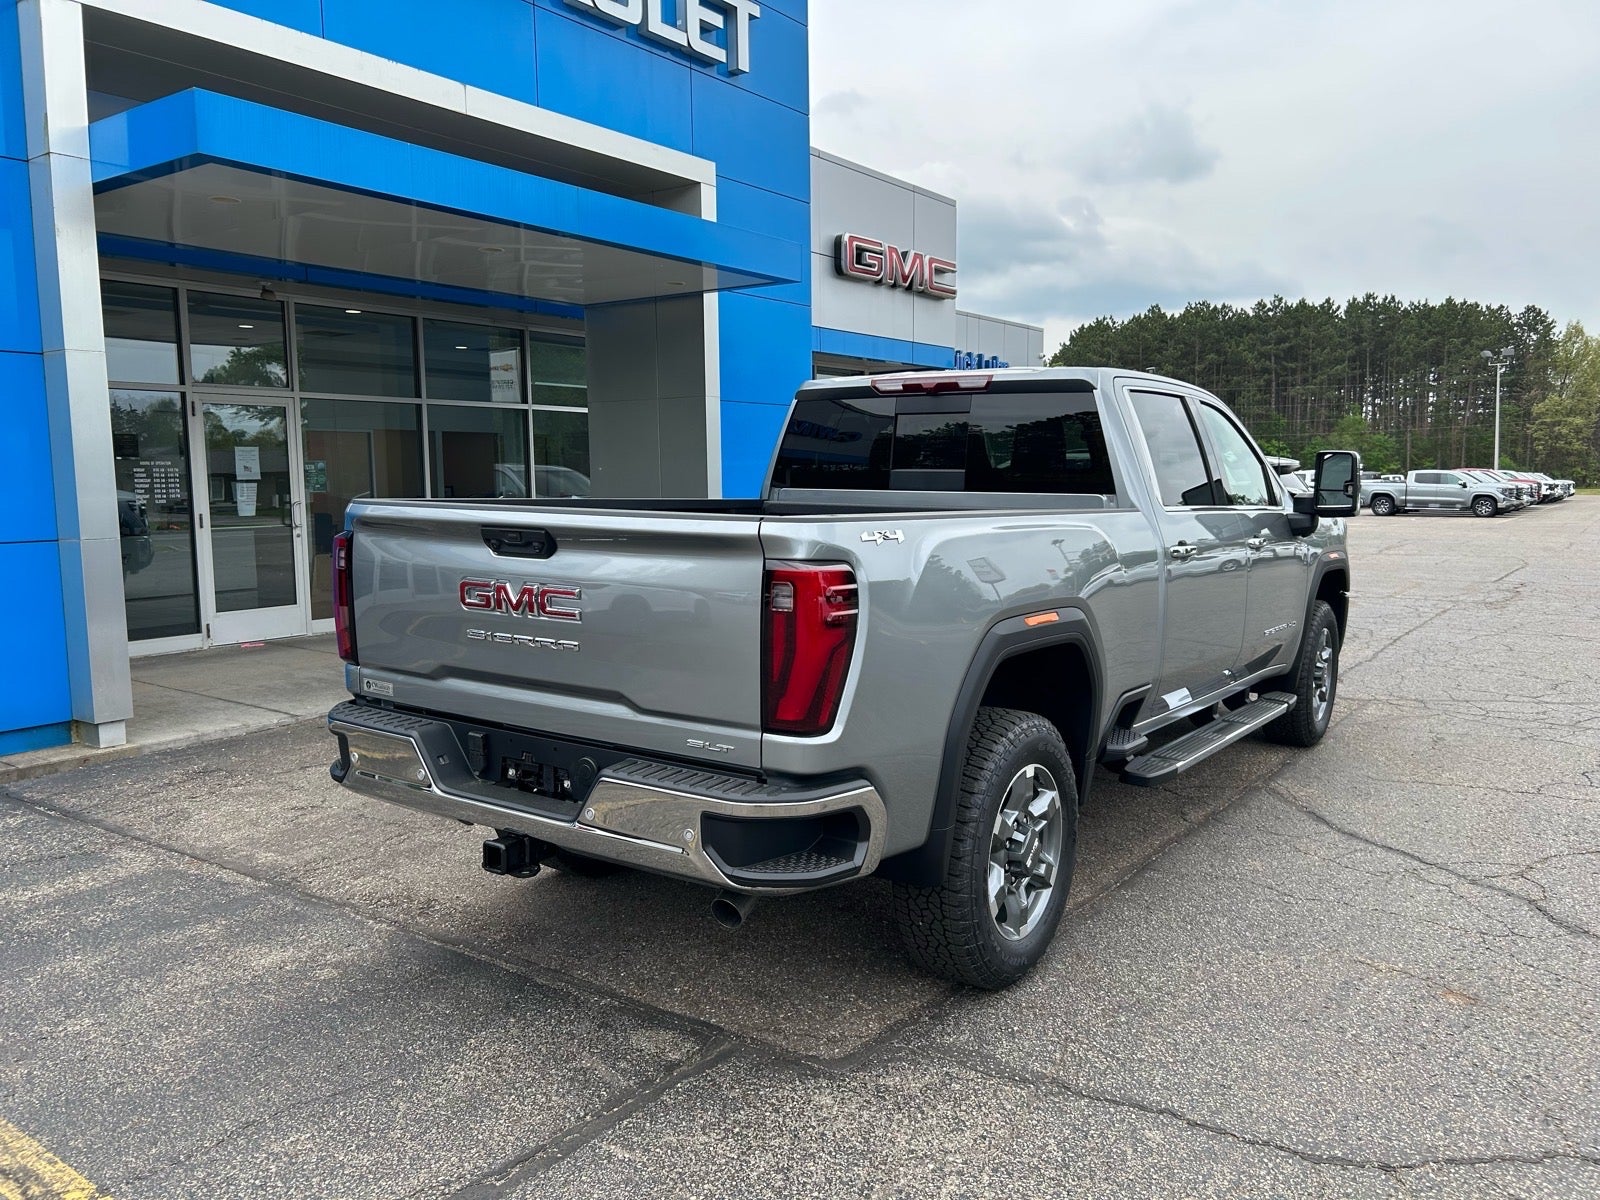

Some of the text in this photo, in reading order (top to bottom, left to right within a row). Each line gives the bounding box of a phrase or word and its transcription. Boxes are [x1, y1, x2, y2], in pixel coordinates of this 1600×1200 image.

[563, 0, 761, 73] LET
[836, 232, 957, 299] GMC
[459, 577, 582, 624] GMC
[466, 628, 580, 652] SIERRA
[686, 739, 735, 753] SLT
